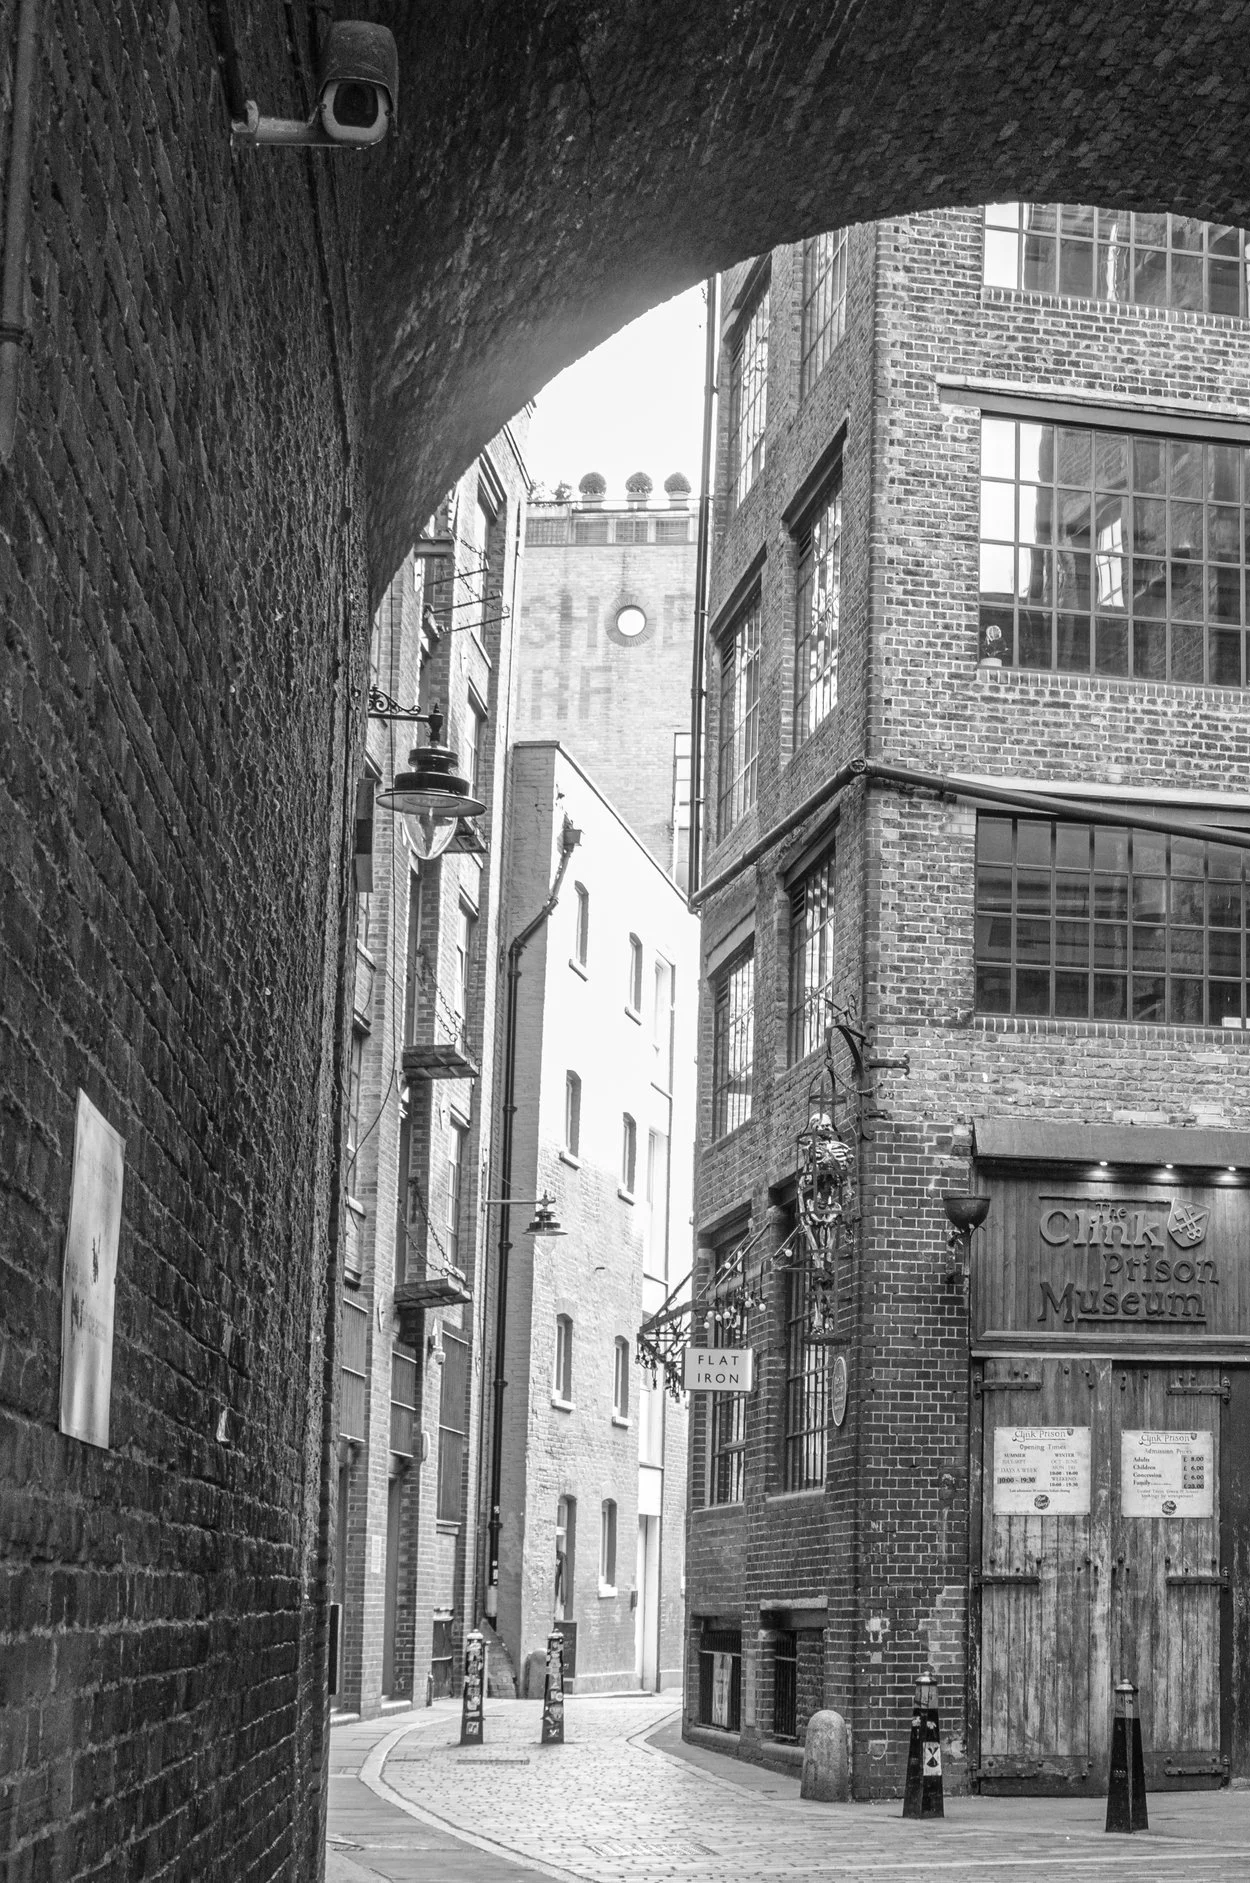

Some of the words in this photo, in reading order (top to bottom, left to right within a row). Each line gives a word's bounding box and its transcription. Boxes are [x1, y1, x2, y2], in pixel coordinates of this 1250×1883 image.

[1096, 1202, 1130, 1223] The
[1039, 1208, 1165, 1250] Clink
[1103, 1252, 1219, 1287] Prison
[1037, 1281, 1206, 1323] Museum
[698, 1355, 739, 1366] FLAT
[697, 1373, 739, 1384] IRON
[1040, 1430, 1066, 1438] Prison
[1164, 1434, 1190, 1442] Prison
